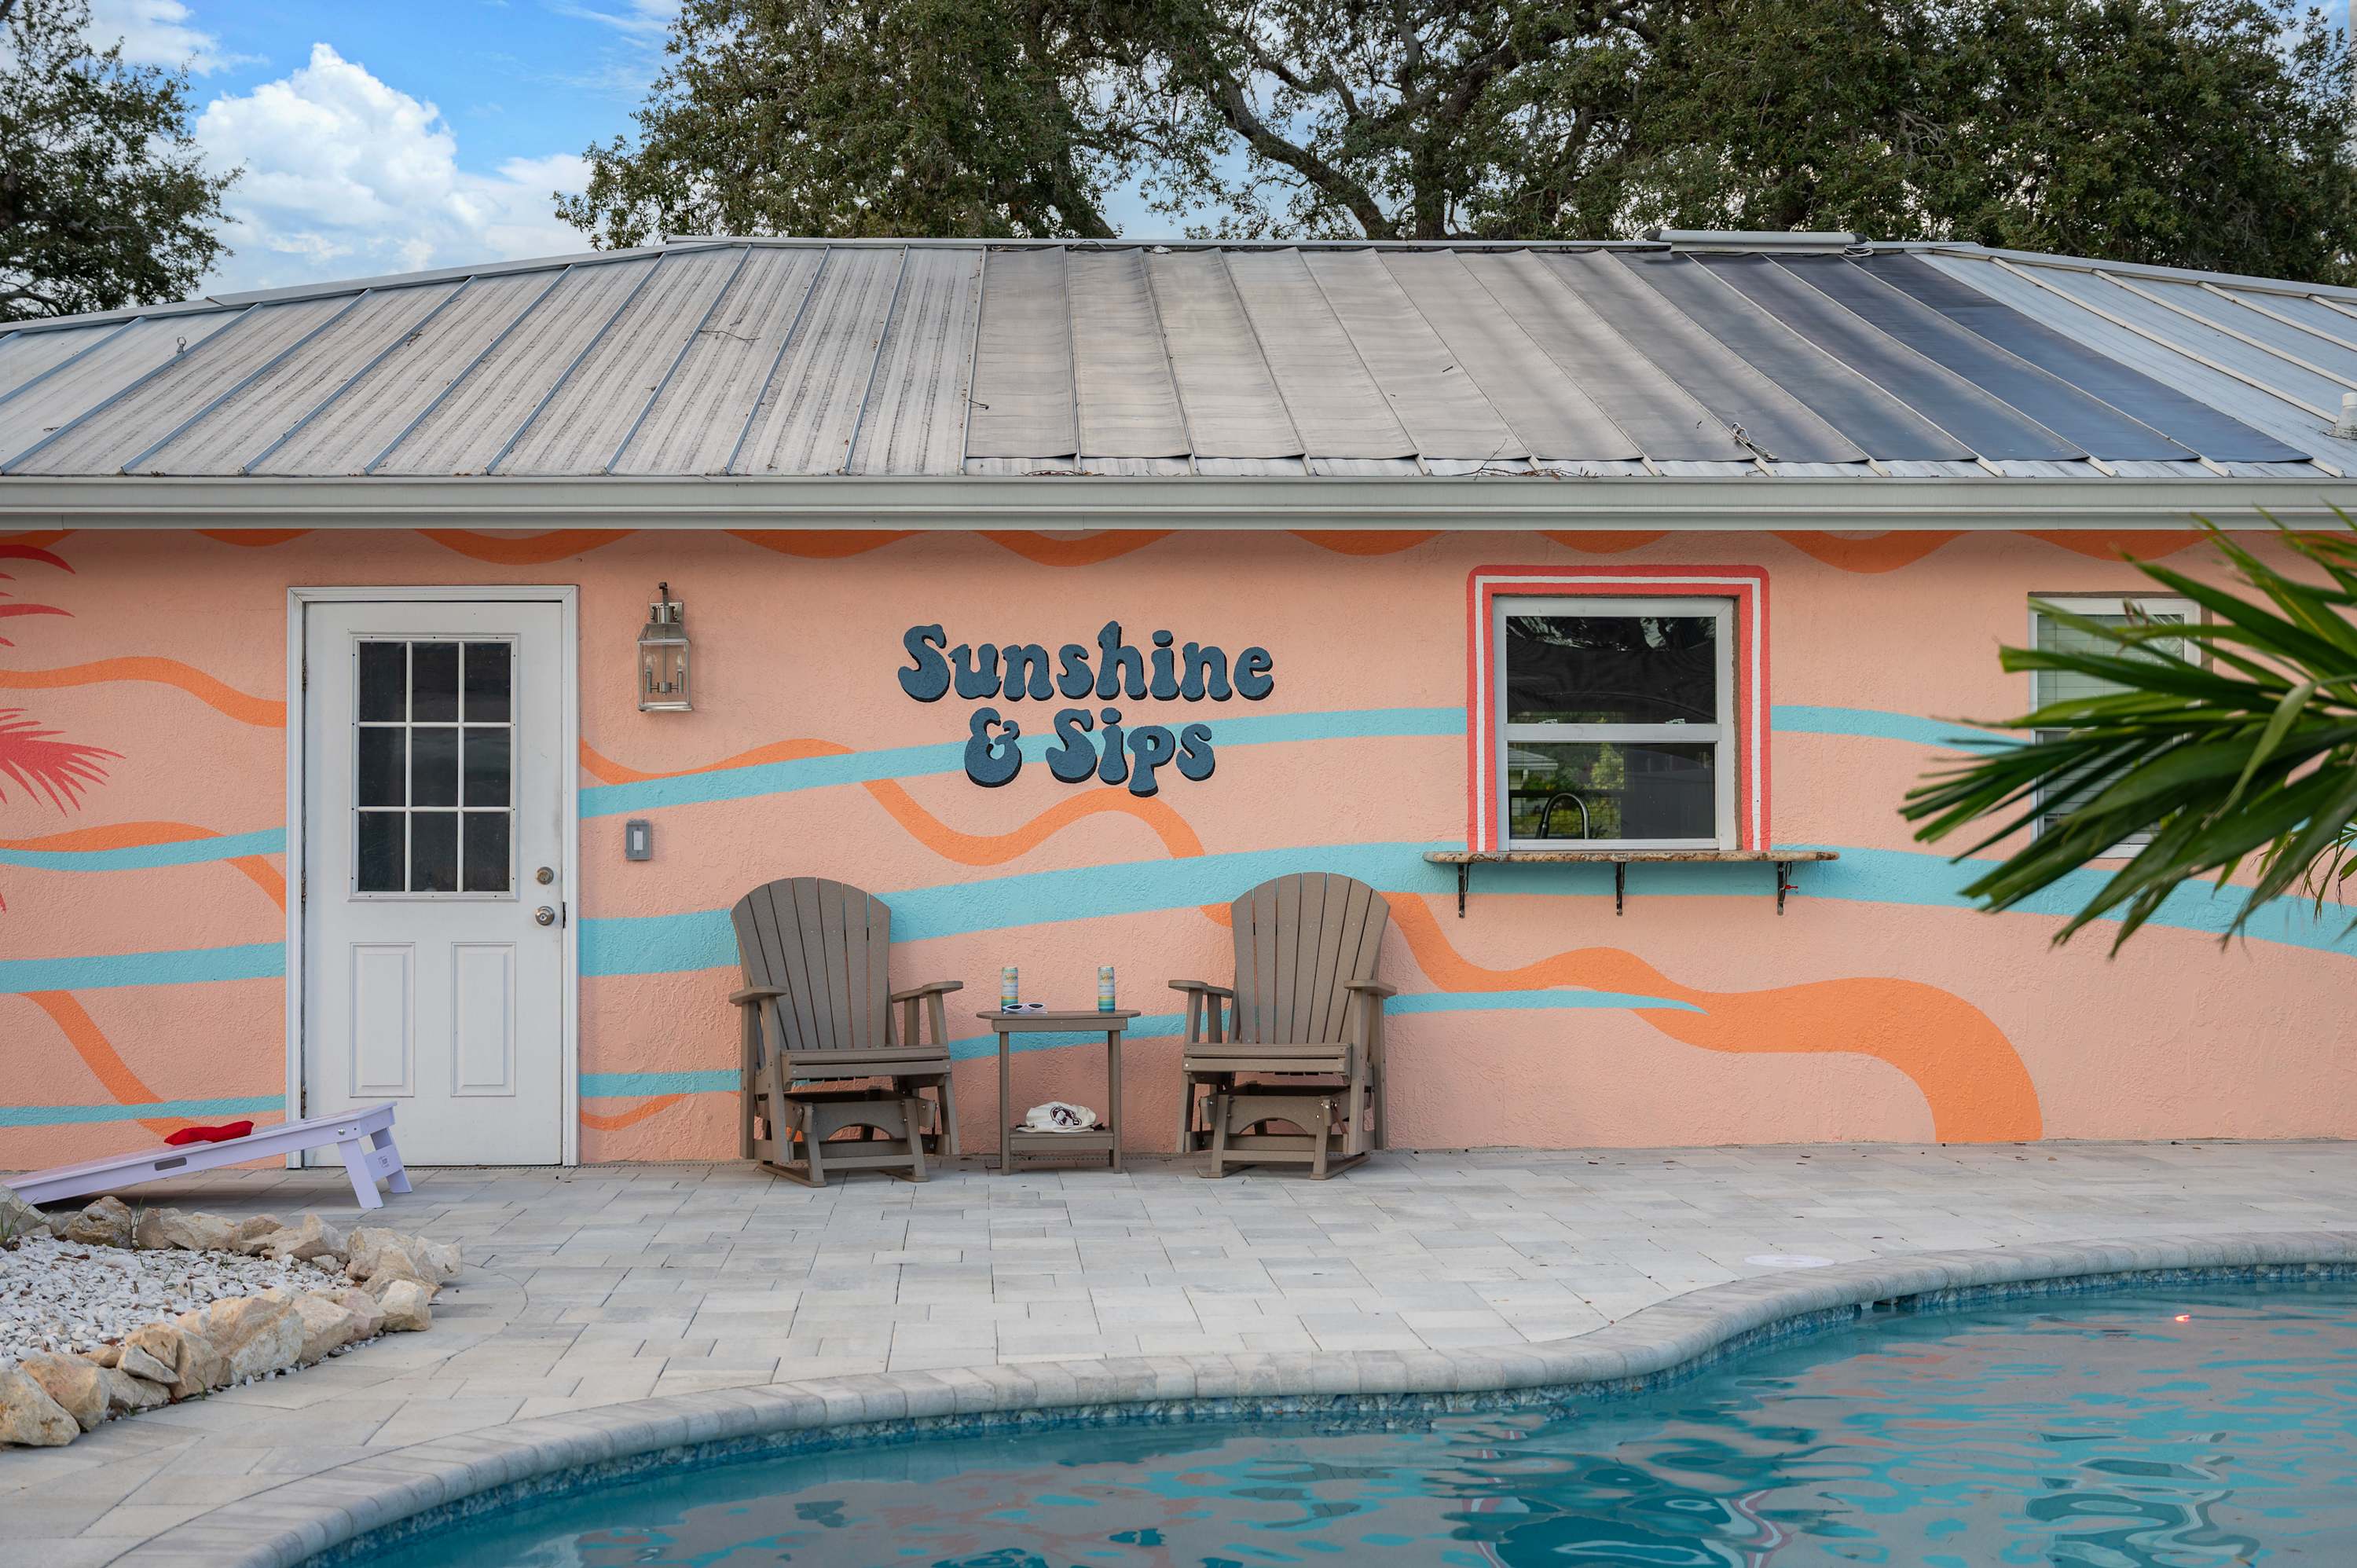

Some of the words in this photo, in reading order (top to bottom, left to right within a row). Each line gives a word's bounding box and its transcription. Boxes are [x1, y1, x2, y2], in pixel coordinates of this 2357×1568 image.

[898, 621, 1274, 702] Sunshine
[964, 707, 1023, 787] &
[1046, 708, 1215, 797] Sips
